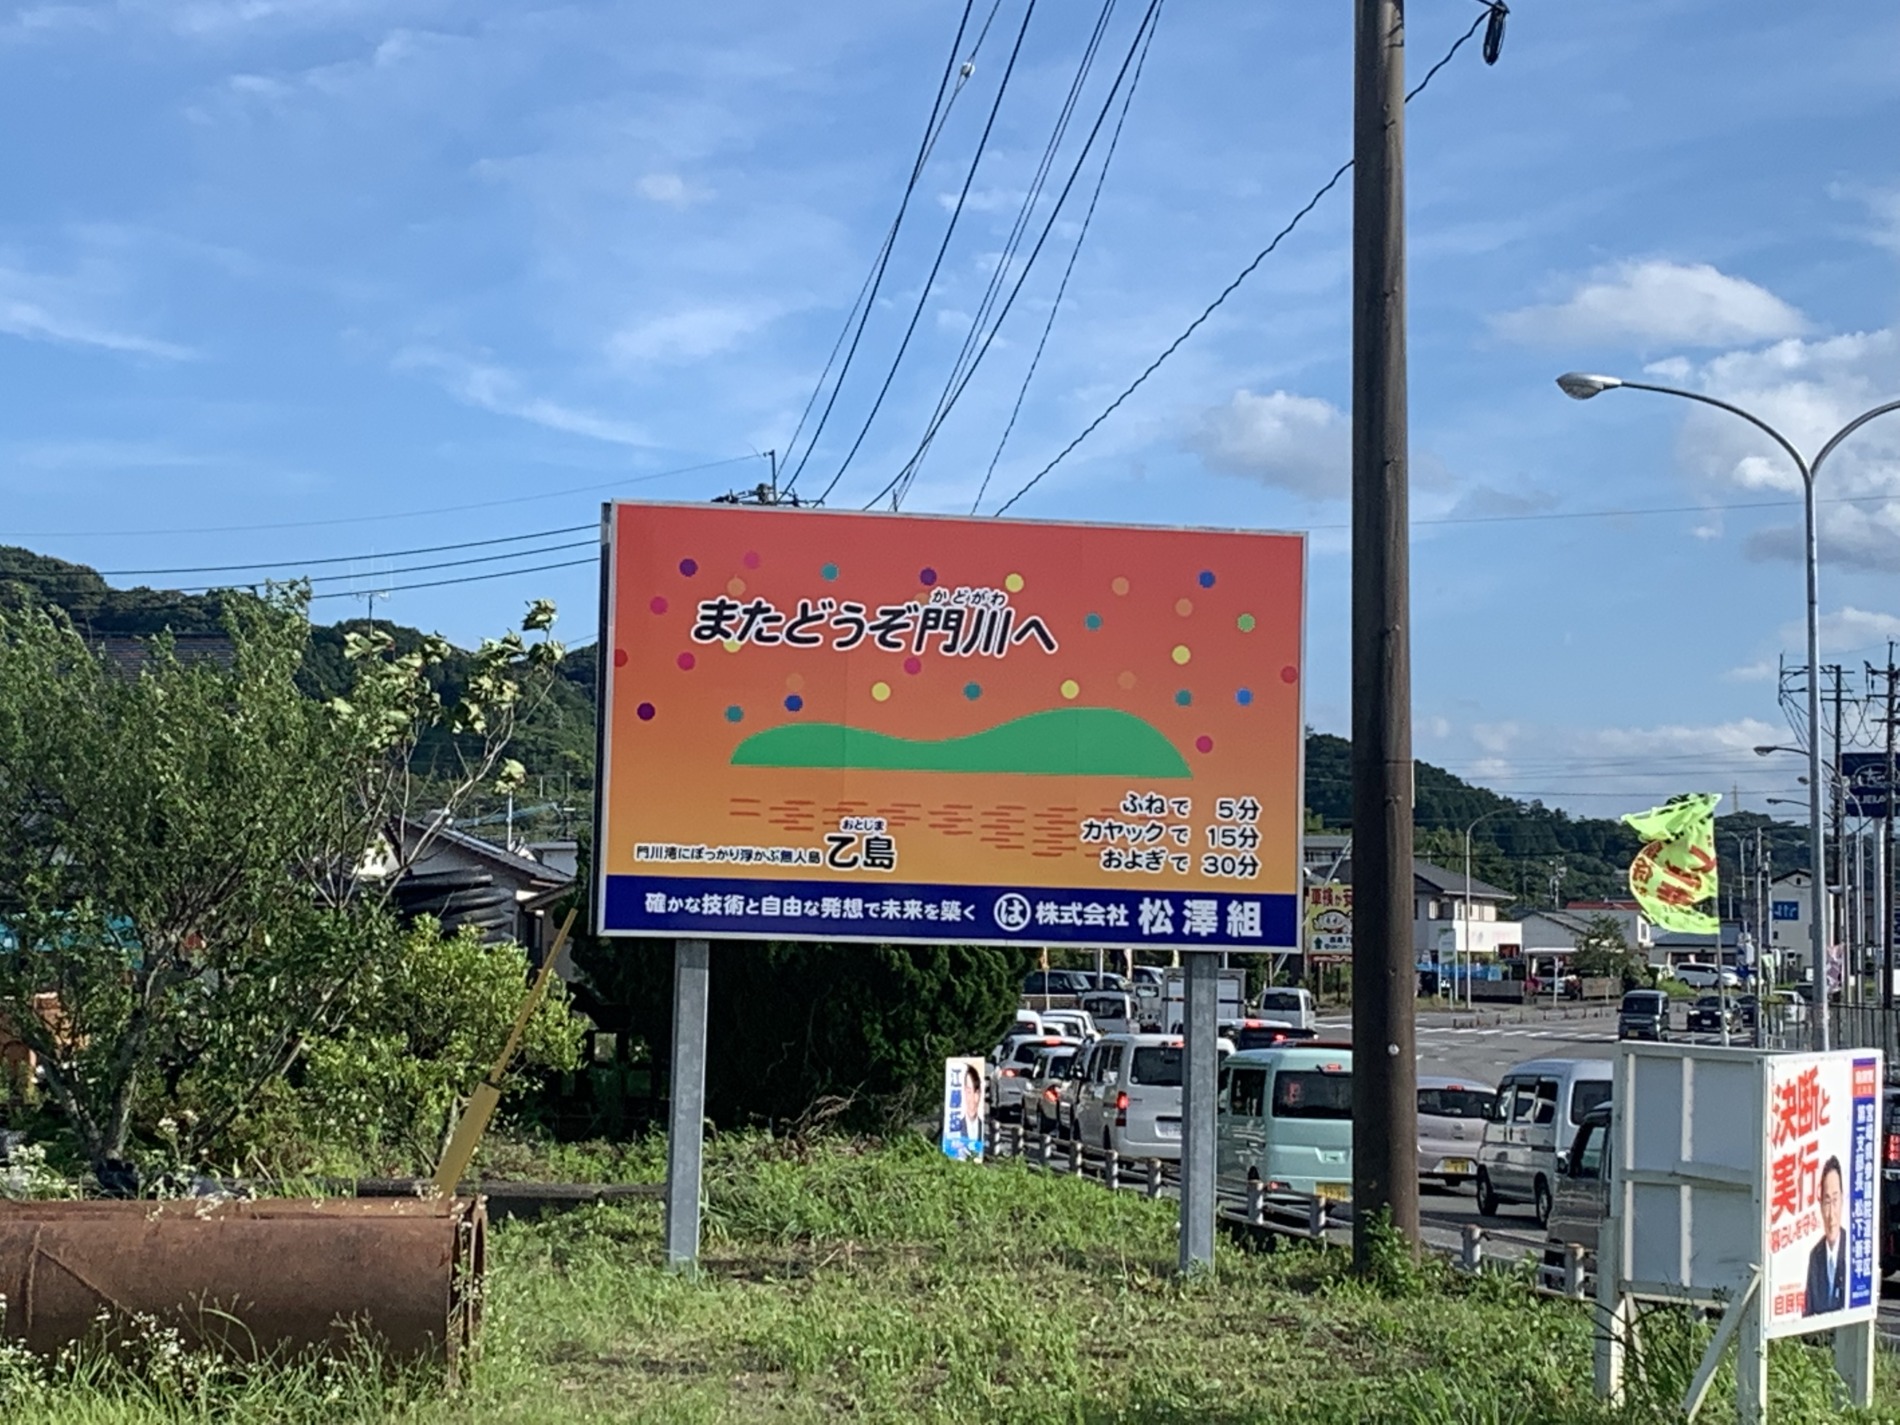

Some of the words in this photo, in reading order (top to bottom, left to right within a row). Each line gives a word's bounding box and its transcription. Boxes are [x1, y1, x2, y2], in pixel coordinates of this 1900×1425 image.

[931, 589, 1006, 605] かどがわ
[692, 598, 1058, 656] またどうぞ門川へ
[1122, 794, 1190, 817] ふねで
[1218, 798, 1260, 821] 5分
[842, 819, 884, 831] おとじま
[1082, 821, 1190, 844] カヤックで
[1207, 827, 1260, 849] 15分
[826, 836, 895, 870] 乙島
[1101, 849, 1190, 872] およぎで
[1202, 854, 1260, 877] 30分
[645, 892, 976, 922] 確かな技術と自由な発想で未来を築く
[1035, 901, 1129, 927] 株式会社
[1138, 897, 1263, 937] 松澤組
[1772, 1065, 1830, 1149] 決断と
